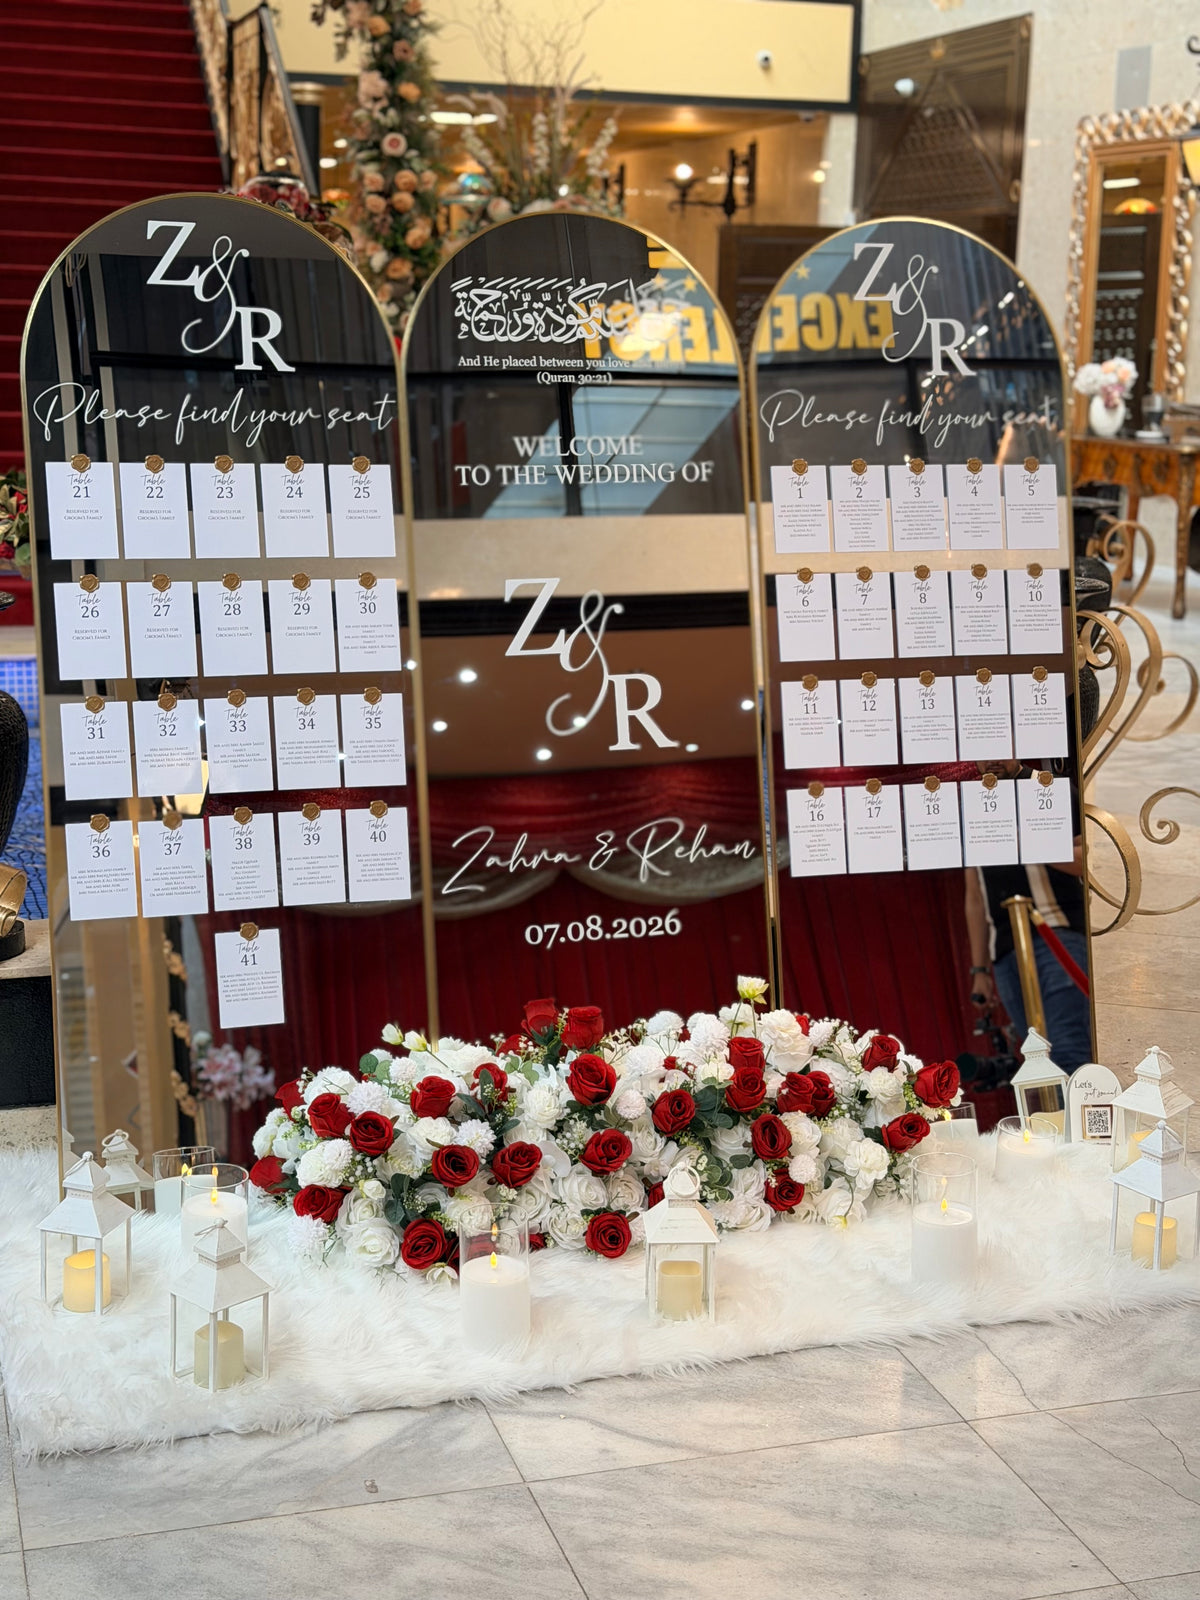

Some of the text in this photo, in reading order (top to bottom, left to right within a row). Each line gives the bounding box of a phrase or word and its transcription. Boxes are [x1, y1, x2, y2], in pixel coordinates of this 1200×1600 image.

[458, 355, 481, 367] And
[484, 355, 500, 367] He
[502, 355, 537, 370] placed
[539, 355, 584, 368] between
[586, 359, 606, 371] you
[608, 356, 630, 368] love
[536, 371, 612, 384] (Quran 30:21)
[33, 381, 397, 448] Please find your seat
[760, 388, 1057, 448] Please find your seat
[513, 435, 644, 458] WELCOME
[68, 474, 94, 486] Table
[282, 474, 305, 486] Table
[455, 461, 714, 487] TO THE WEDDING OF
[963, 474, 983, 486] Table
[1021, 474, 1040, 485] Table
[141, 474, 166, 487] Table
[211, 474, 236, 487] Table
[349, 474, 372, 487] Table
[788, 476, 809, 487] Table
[848, 476, 868, 487] Table
[906, 476, 926, 487] Table
[74, 486, 91, 498] 21
[147, 486, 164, 498] 22
[216, 486, 233, 498] 23
[287, 486, 303, 498] 24
[355, 486, 370, 498] 25
[798, 488, 803, 498] 1
[856, 487, 863, 498] 2
[914, 487, 921, 498] 3
[971, 486, 978, 496] 4
[1028, 485, 1034, 496] 5
[853, 583, 873, 594] Table
[911, 581, 932, 592] Table
[968, 580, 988, 591] Table
[1024, 578, 1044, 589] Table
[354, 590, 378, 602] Table
[793, 584, 814, 596] Table
[1028, 590, 1042, 601] 10
[77, 594, 103, 606] Table
[148, 592, 173, 605] Table
[220, 591, 244, 604] Table
[289, 591, 312, 603] Table
[802, 596, 809, 607] 6
[861, 594, 868, 605] 7
[919, 592, 927, 604] 8
[976, 591, 983, 602] 9
[82, 606, 99, 618] 26
[154, 604, 170, 616] 27
[225, 603, 241, 615] 28
[294, 603, 310, 615] 29
[359, 602, 376, 614] 30
[917, 687, 936, 698] Table
[974, 684, 992, 695] Table
[1029, 682, 1048, 693] Table
[799, 691, 820, 702] Table
[857, 689, 878, 700] Table
[1033, 693, 1047, 705] 15
[863, 700, 877, 711] 12
[920, 698, 935, 710] 13
[978, 695, 992, 707] 14
[224, 708, 249, 721] Table
[293, 706, 317, 718] Table
[360, 705, 383, 718] Table
[803, 703, 818, 714] 11
[83, 715, 109, 728] Table
[154, 712, 179, 725] Table
[298, 718, 315, 730] 34
[365, 717, 381, 729] 35
[159, 724, 176, 736] 32
[229, 720, 246, 732] 33
[88, 727, 105, 739] 31
[921, 792, 941, 803] Table
[979, 789, 999, 800] Table
[1034, 787, 1054, 798] Table
[804, 798, 825, 809] Table
[862, 795, 883, 806] Table
[985, 801, 997, 812] 19
[1038, 798, 1052, 810] 20
[867, 806, 881, 818] 17
[925, 803, 940, 815] 18
[809, 810, 824, 821] 16
[298, 821, 322, 834] Table
[364, 818, 388, 831] Table
[159, 831, 184, 844] Table
[231, 826, 255, 838] Table
[369, 830, 386, 842] 40
[88, 834, 114, 847] Table
[236, 838, 252, 850] 38
[303, 833, 320, 845] 39
[93, 846, 110, 858] 36
[165, 843, 181, 855] 37
[441, 826, 582, 895] Zahra
[588, 830, 620, 870] &
[626, 817, 756, 883] Rehan
[524, 908, 682, 950] 07.08.2026
[235, 942, 260, 954] Table
[240, 954, 258, 966] 41
[1074, 1080, 1092, 1089] Let's
